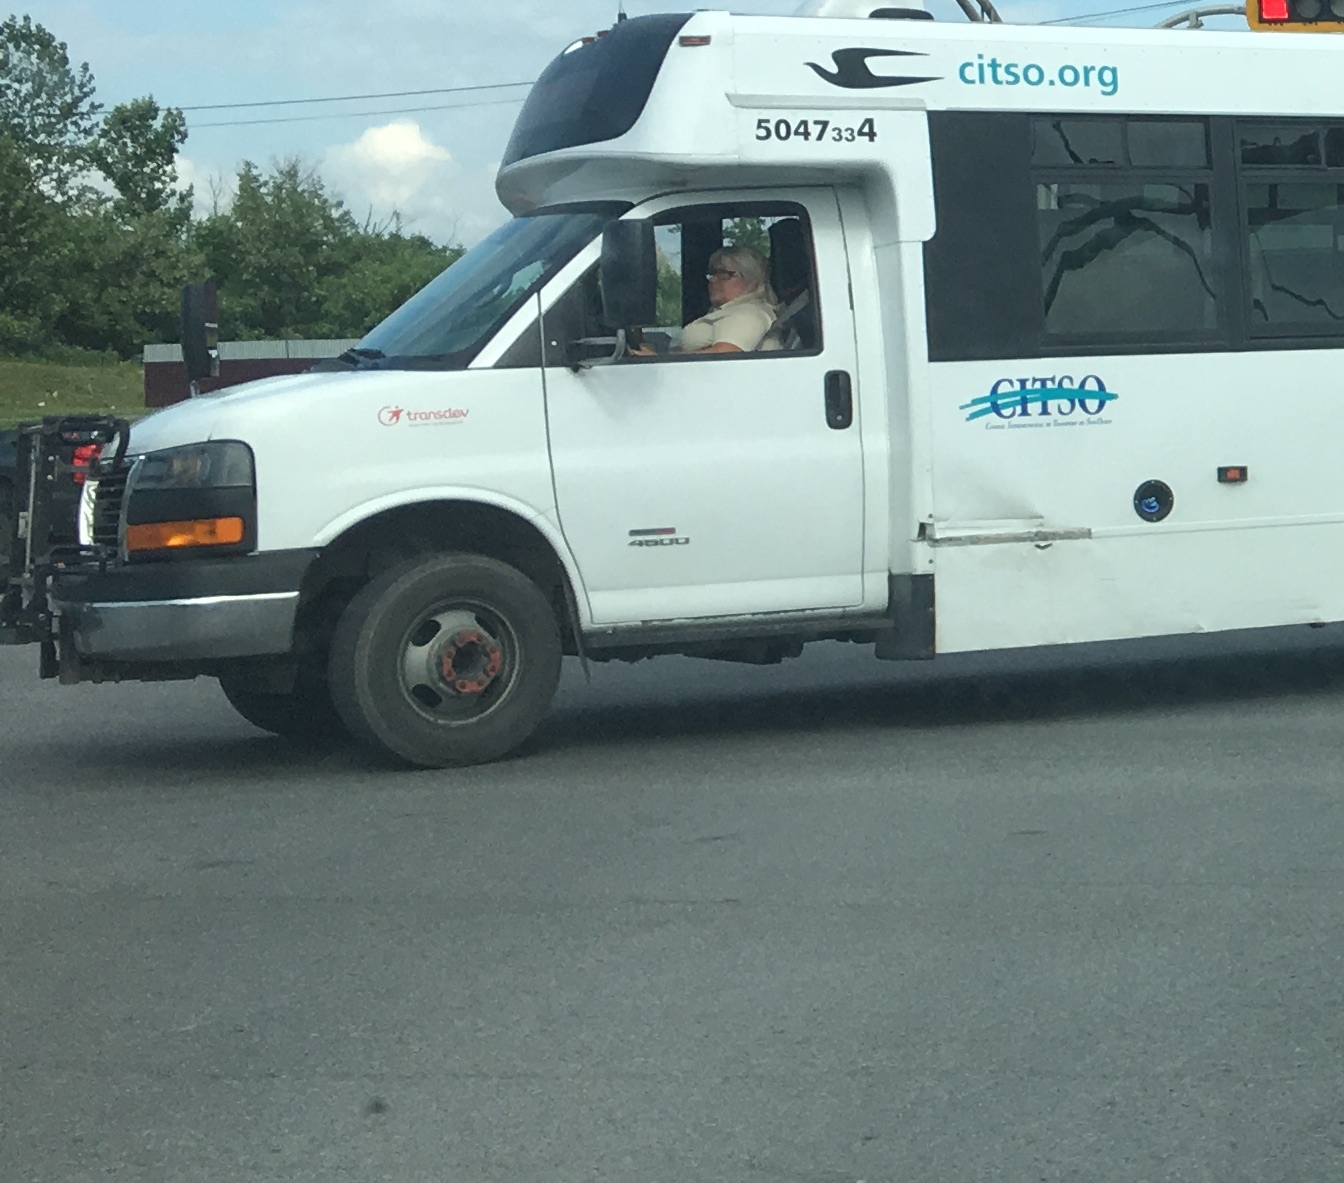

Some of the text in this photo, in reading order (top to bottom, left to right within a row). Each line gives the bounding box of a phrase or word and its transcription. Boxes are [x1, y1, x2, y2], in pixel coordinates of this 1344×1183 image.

[958, 53, 1119, 96] citso.org
[406, 408, 469, 421] transdev
[990, 374, 1107, 420] CITSO
